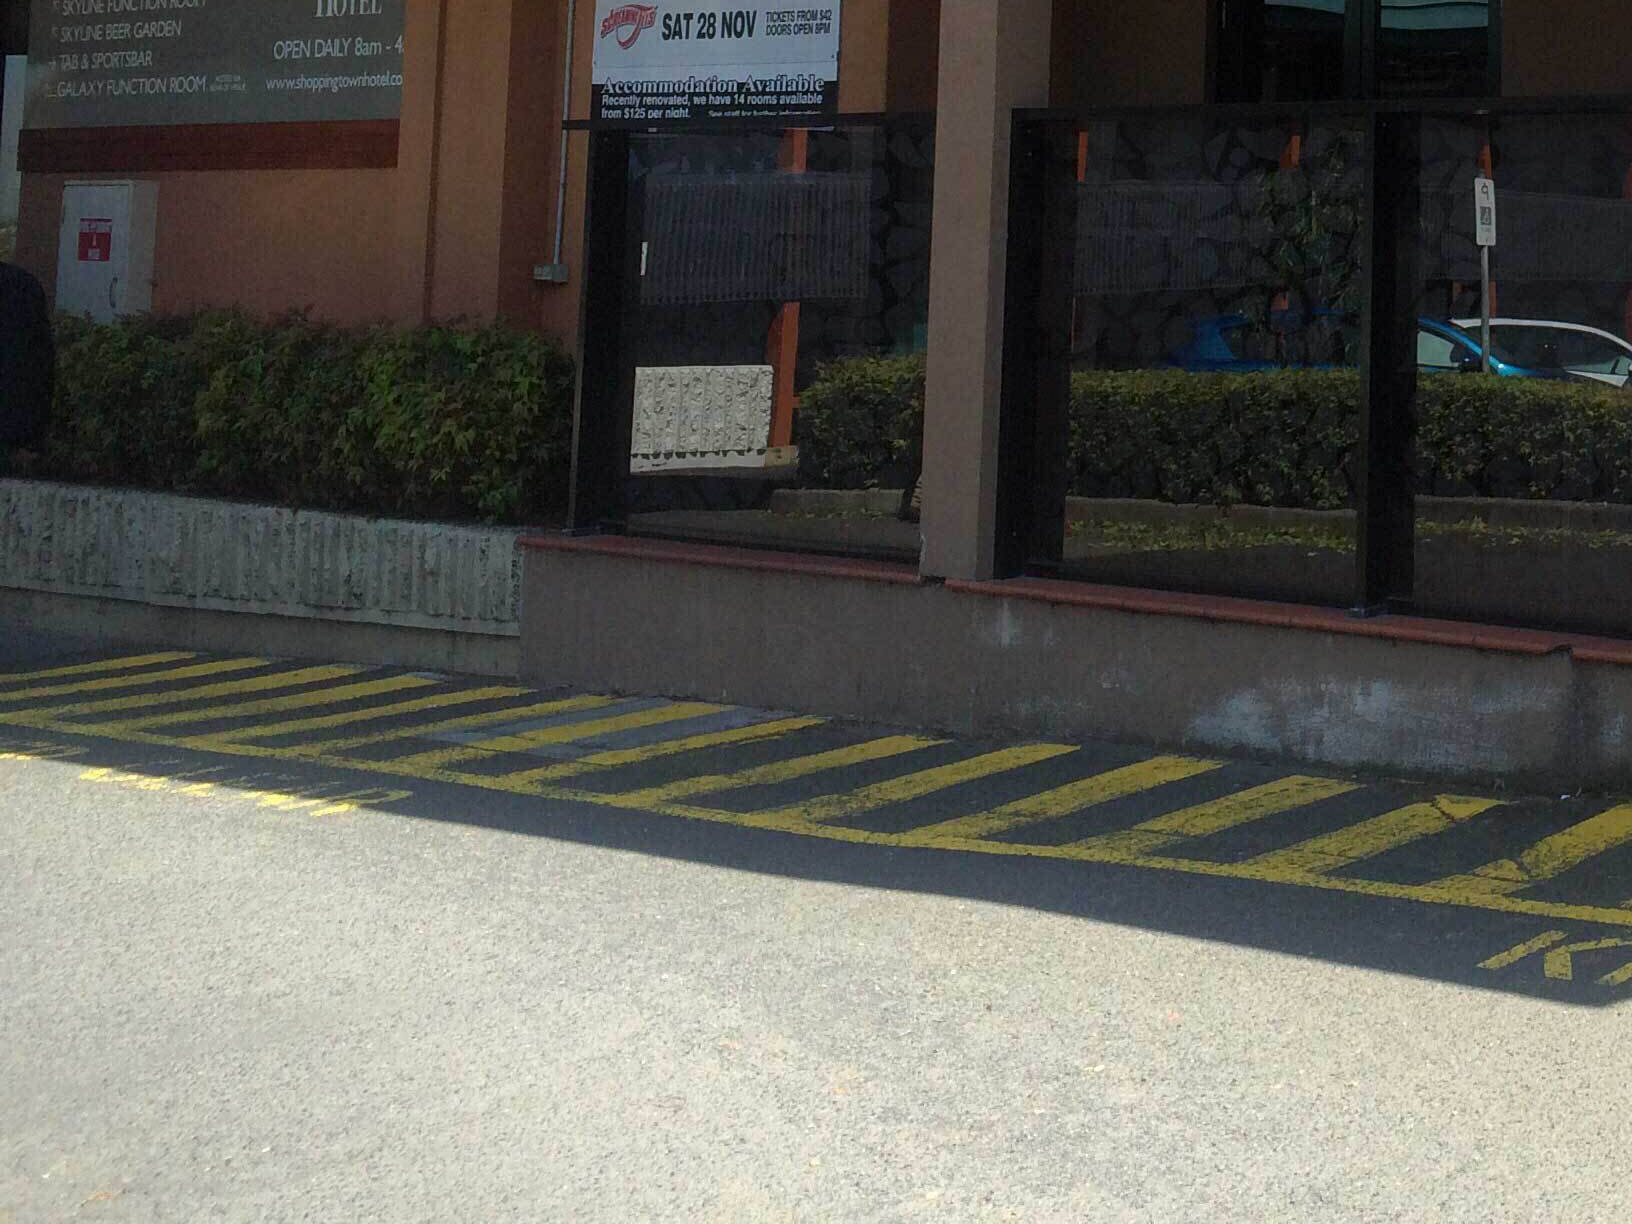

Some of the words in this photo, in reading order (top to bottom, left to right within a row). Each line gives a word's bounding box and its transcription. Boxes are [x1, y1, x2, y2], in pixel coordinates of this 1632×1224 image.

[662, 12, 693, 41] SAT
[697, 12, 716, 39] 28
[720, 10, 757, 39] NOV
[766, 10, 795, 22] TICKETS
[797, 9, 818, 22] FROM
[60, 24, 103, 43] SKYLINE
[106, 22, 131, 40] BEER
[133, 19, 182, 38] GARDEN
[766, 23, 792, 35] DOORS
[793, 23, 813, 35] OPEN
[273, 39, 311, 59] OPEN
[314, 37, 352, 57] DAILY
[354, 36, 382, 56] 8am
[60, 53, 79, 71] TAB
[80, 53, 89, 70] &
[91, 50, 153, 70] SPORTSBAR
[57, 79, 104, 97] GALAXY
[107, 78, 167, 95] FUNCTION
[170, 75, 206, 93] ROOM
[601, 76, 738, 94] Accommodation
[742, 74, 825, 92] Available
[602, 93, 640, 107] Recently
[643, 93, 690, 106] renovated,
[693, 95, 707, 105] we
[708, 93, 732, 105] have
[734, 93, 745, 105] 14
[747, 94, 777, 105] rooms
[779, 92, 823, 105] available
[601, 108, 622, 119] from
[624, 107, 646, 120] $125
[648, 110, 662, 120] per
